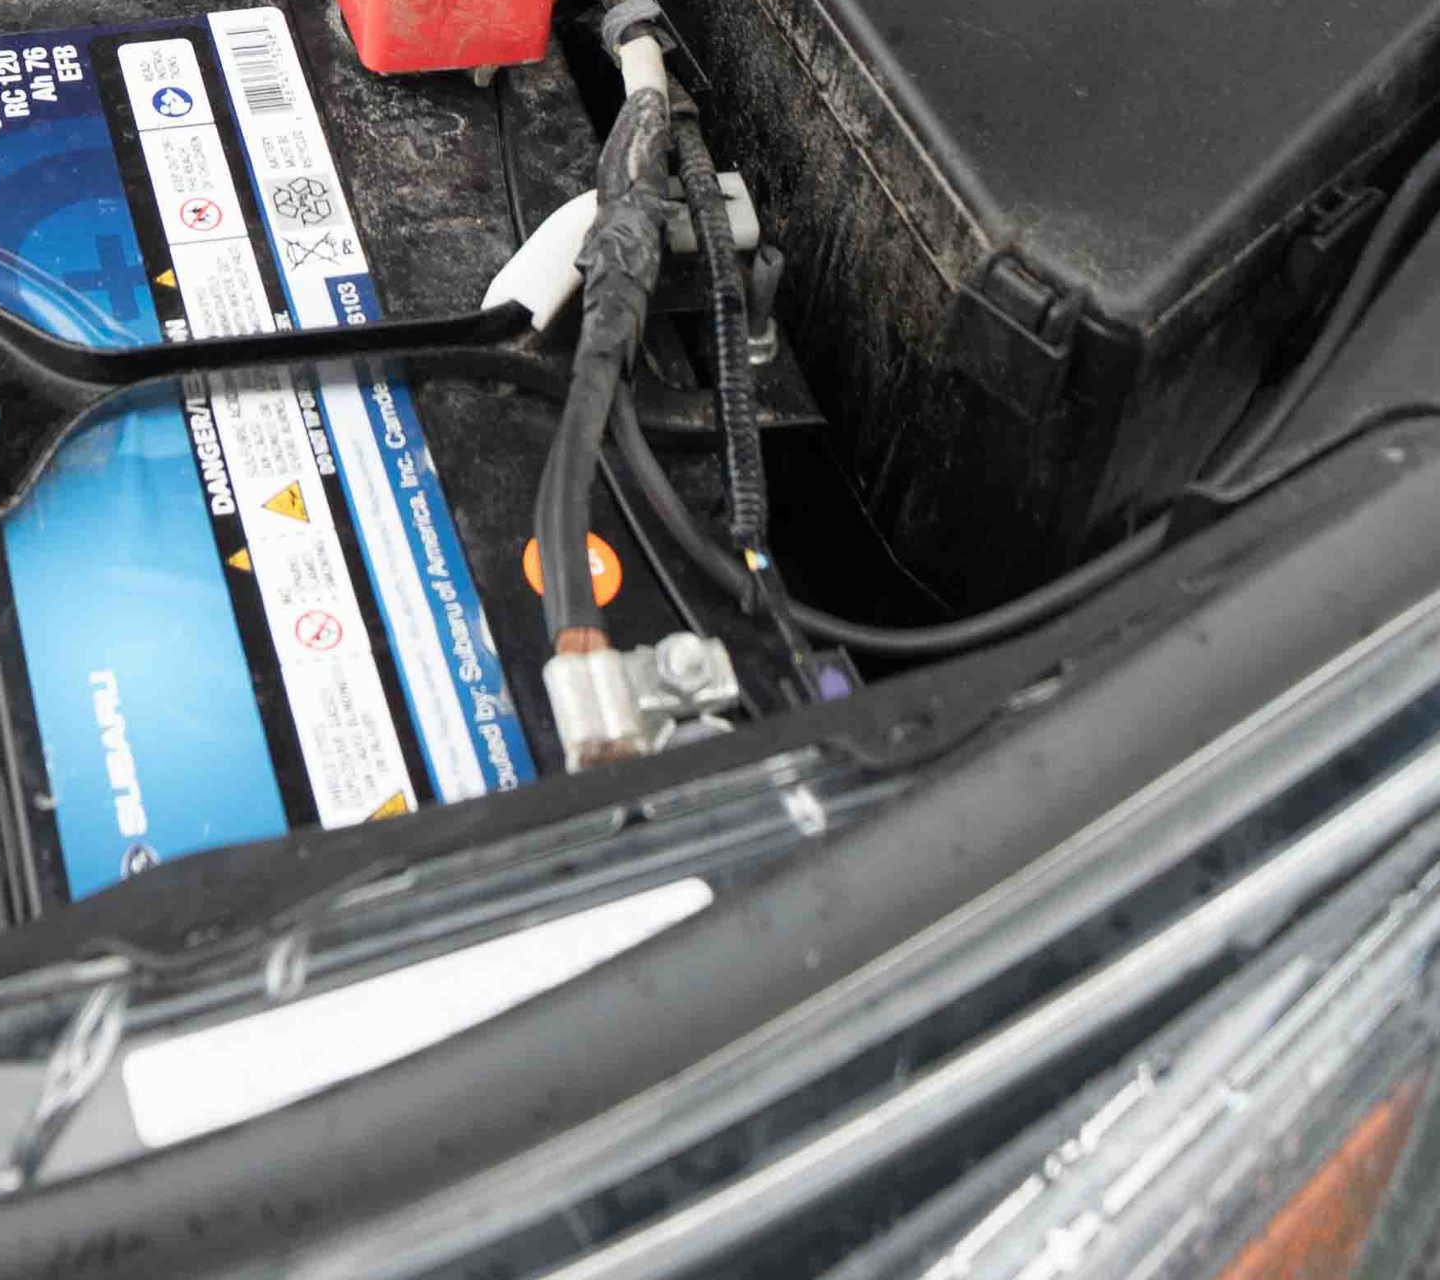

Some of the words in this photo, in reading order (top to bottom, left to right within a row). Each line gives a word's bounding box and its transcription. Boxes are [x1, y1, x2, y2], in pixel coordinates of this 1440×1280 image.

[24, 47, 51, 73] 76
[53, 45, 84, 82] EFB
[0, 89, 30, 117] RC
[30, 75, 58, 102] Ah
[371, 380, 407, 450] Camde
[394, 451, 421, 488] Inc.
[433, 578, 458, 601] of
[442, 601, 485, 682] Subaru
[88, 669, 149, 838] SUBARU
